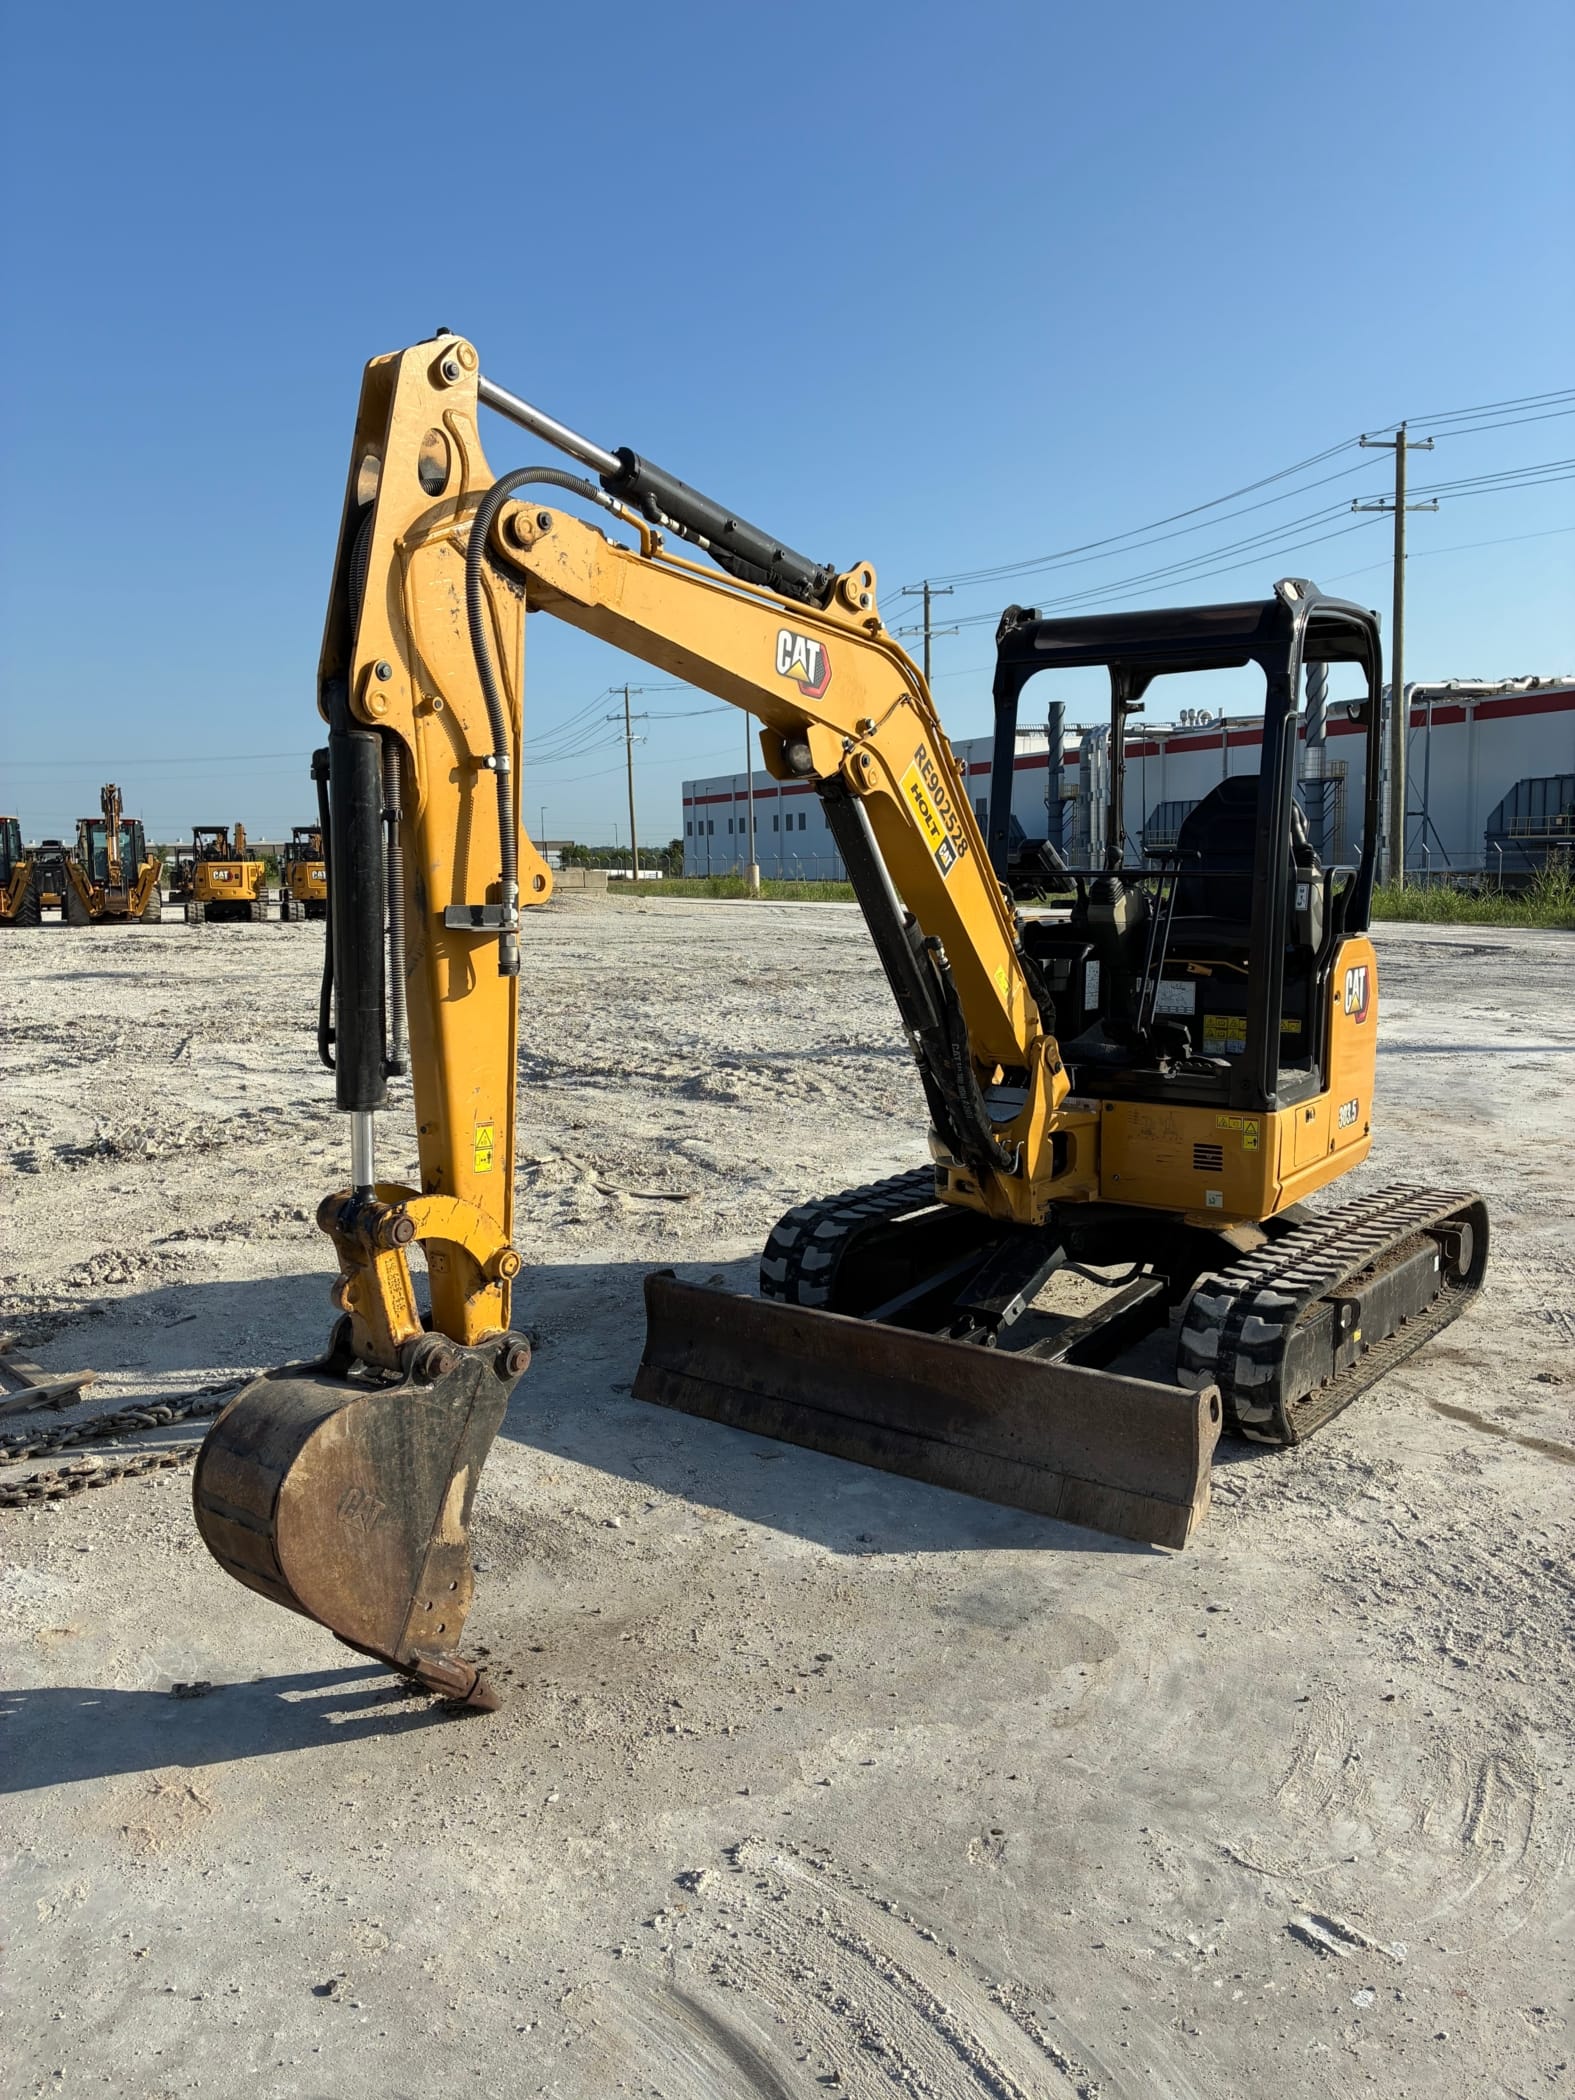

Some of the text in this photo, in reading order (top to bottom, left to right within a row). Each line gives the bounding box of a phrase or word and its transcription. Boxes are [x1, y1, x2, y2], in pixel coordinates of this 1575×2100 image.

[776, 629, 821, 684] CAT
[910, 783, 953, 868] HOLT CAT
[914, 743, 968, 858] RE902528
[212, 870, 229, 880] CAT
[1345, 967, 1366, 1014] CAT
[338, 1488, 386, 1533] CAT
